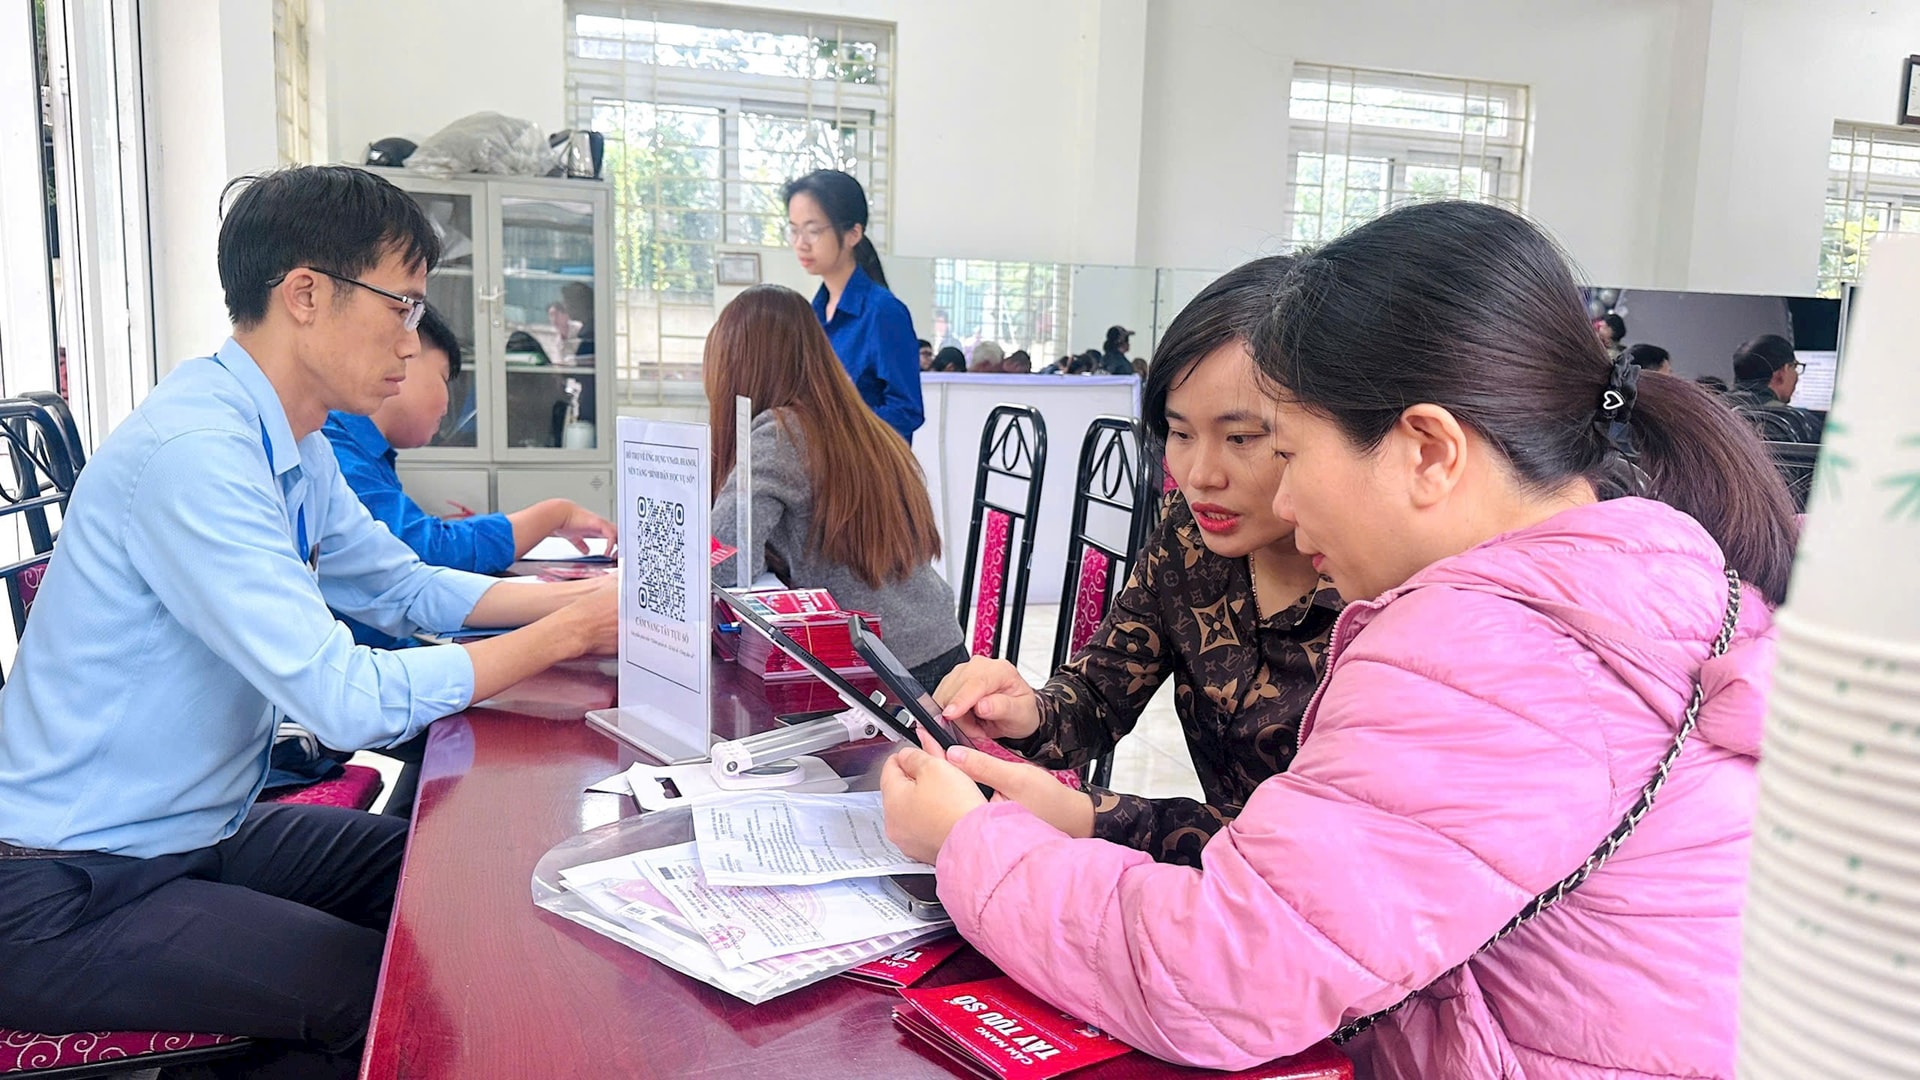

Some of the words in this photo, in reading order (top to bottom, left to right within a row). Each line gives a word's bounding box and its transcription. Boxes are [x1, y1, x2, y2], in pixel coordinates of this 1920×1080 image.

[943, 995, 989, 1012] SỐ
[976, 1012, 1024, 1036] TỰU
[974, 1026, 1008, 1048] NANG
[1011, 1034, 1061, 1061] TÂY
